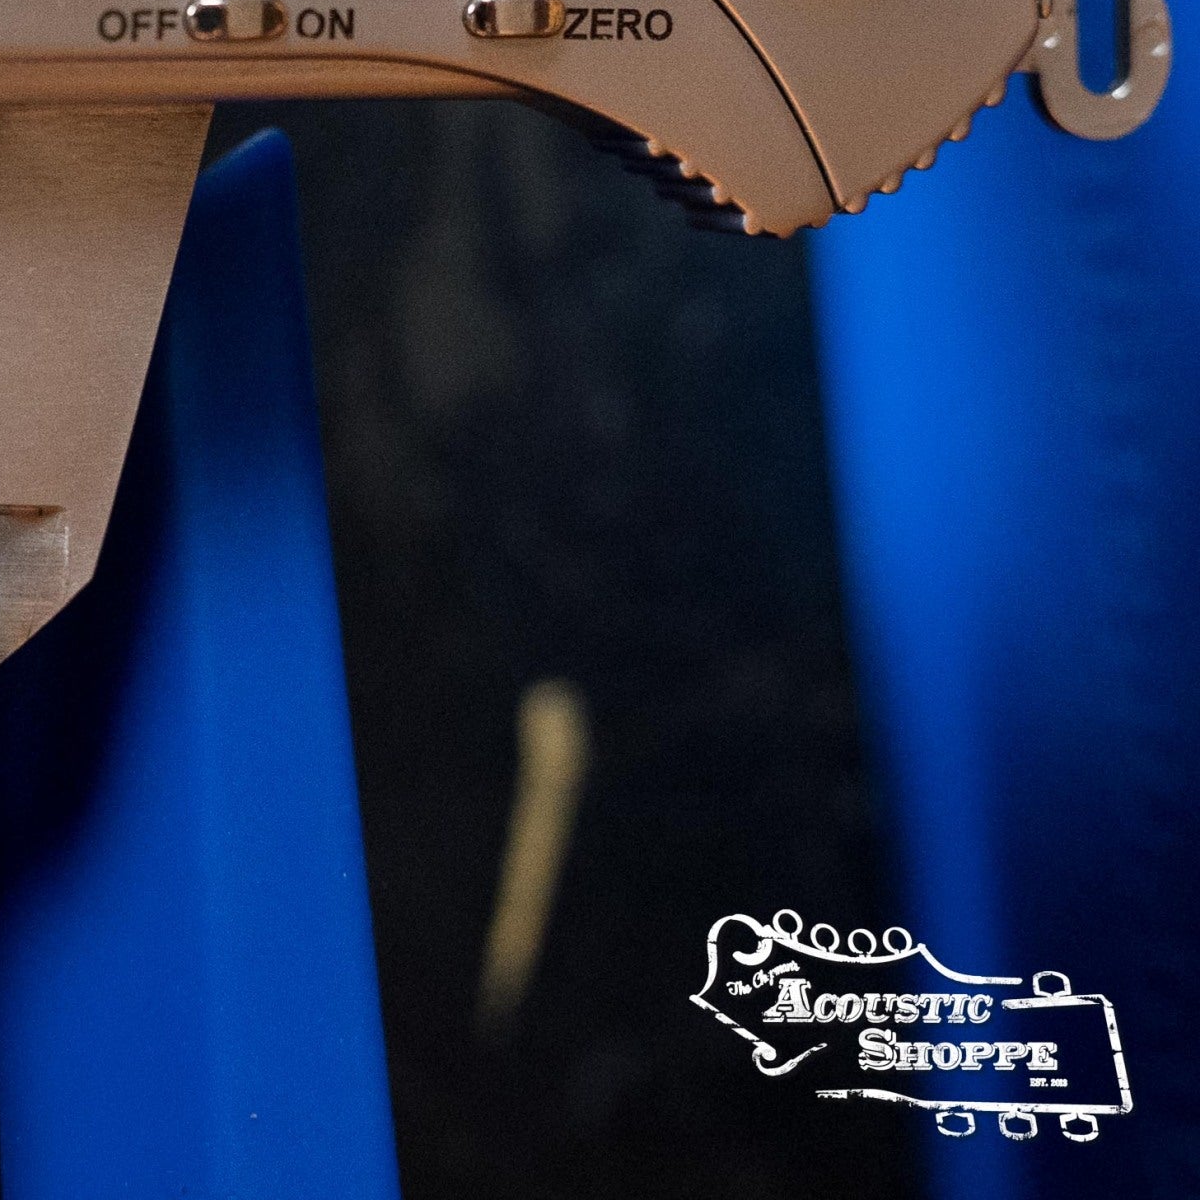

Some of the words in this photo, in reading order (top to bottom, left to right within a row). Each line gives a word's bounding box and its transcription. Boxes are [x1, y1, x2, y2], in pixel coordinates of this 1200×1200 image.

[99, 9, 184, 42] OFF
[296, 9, 356, 41] ON
[563, 9, 673, 42] ZERO
